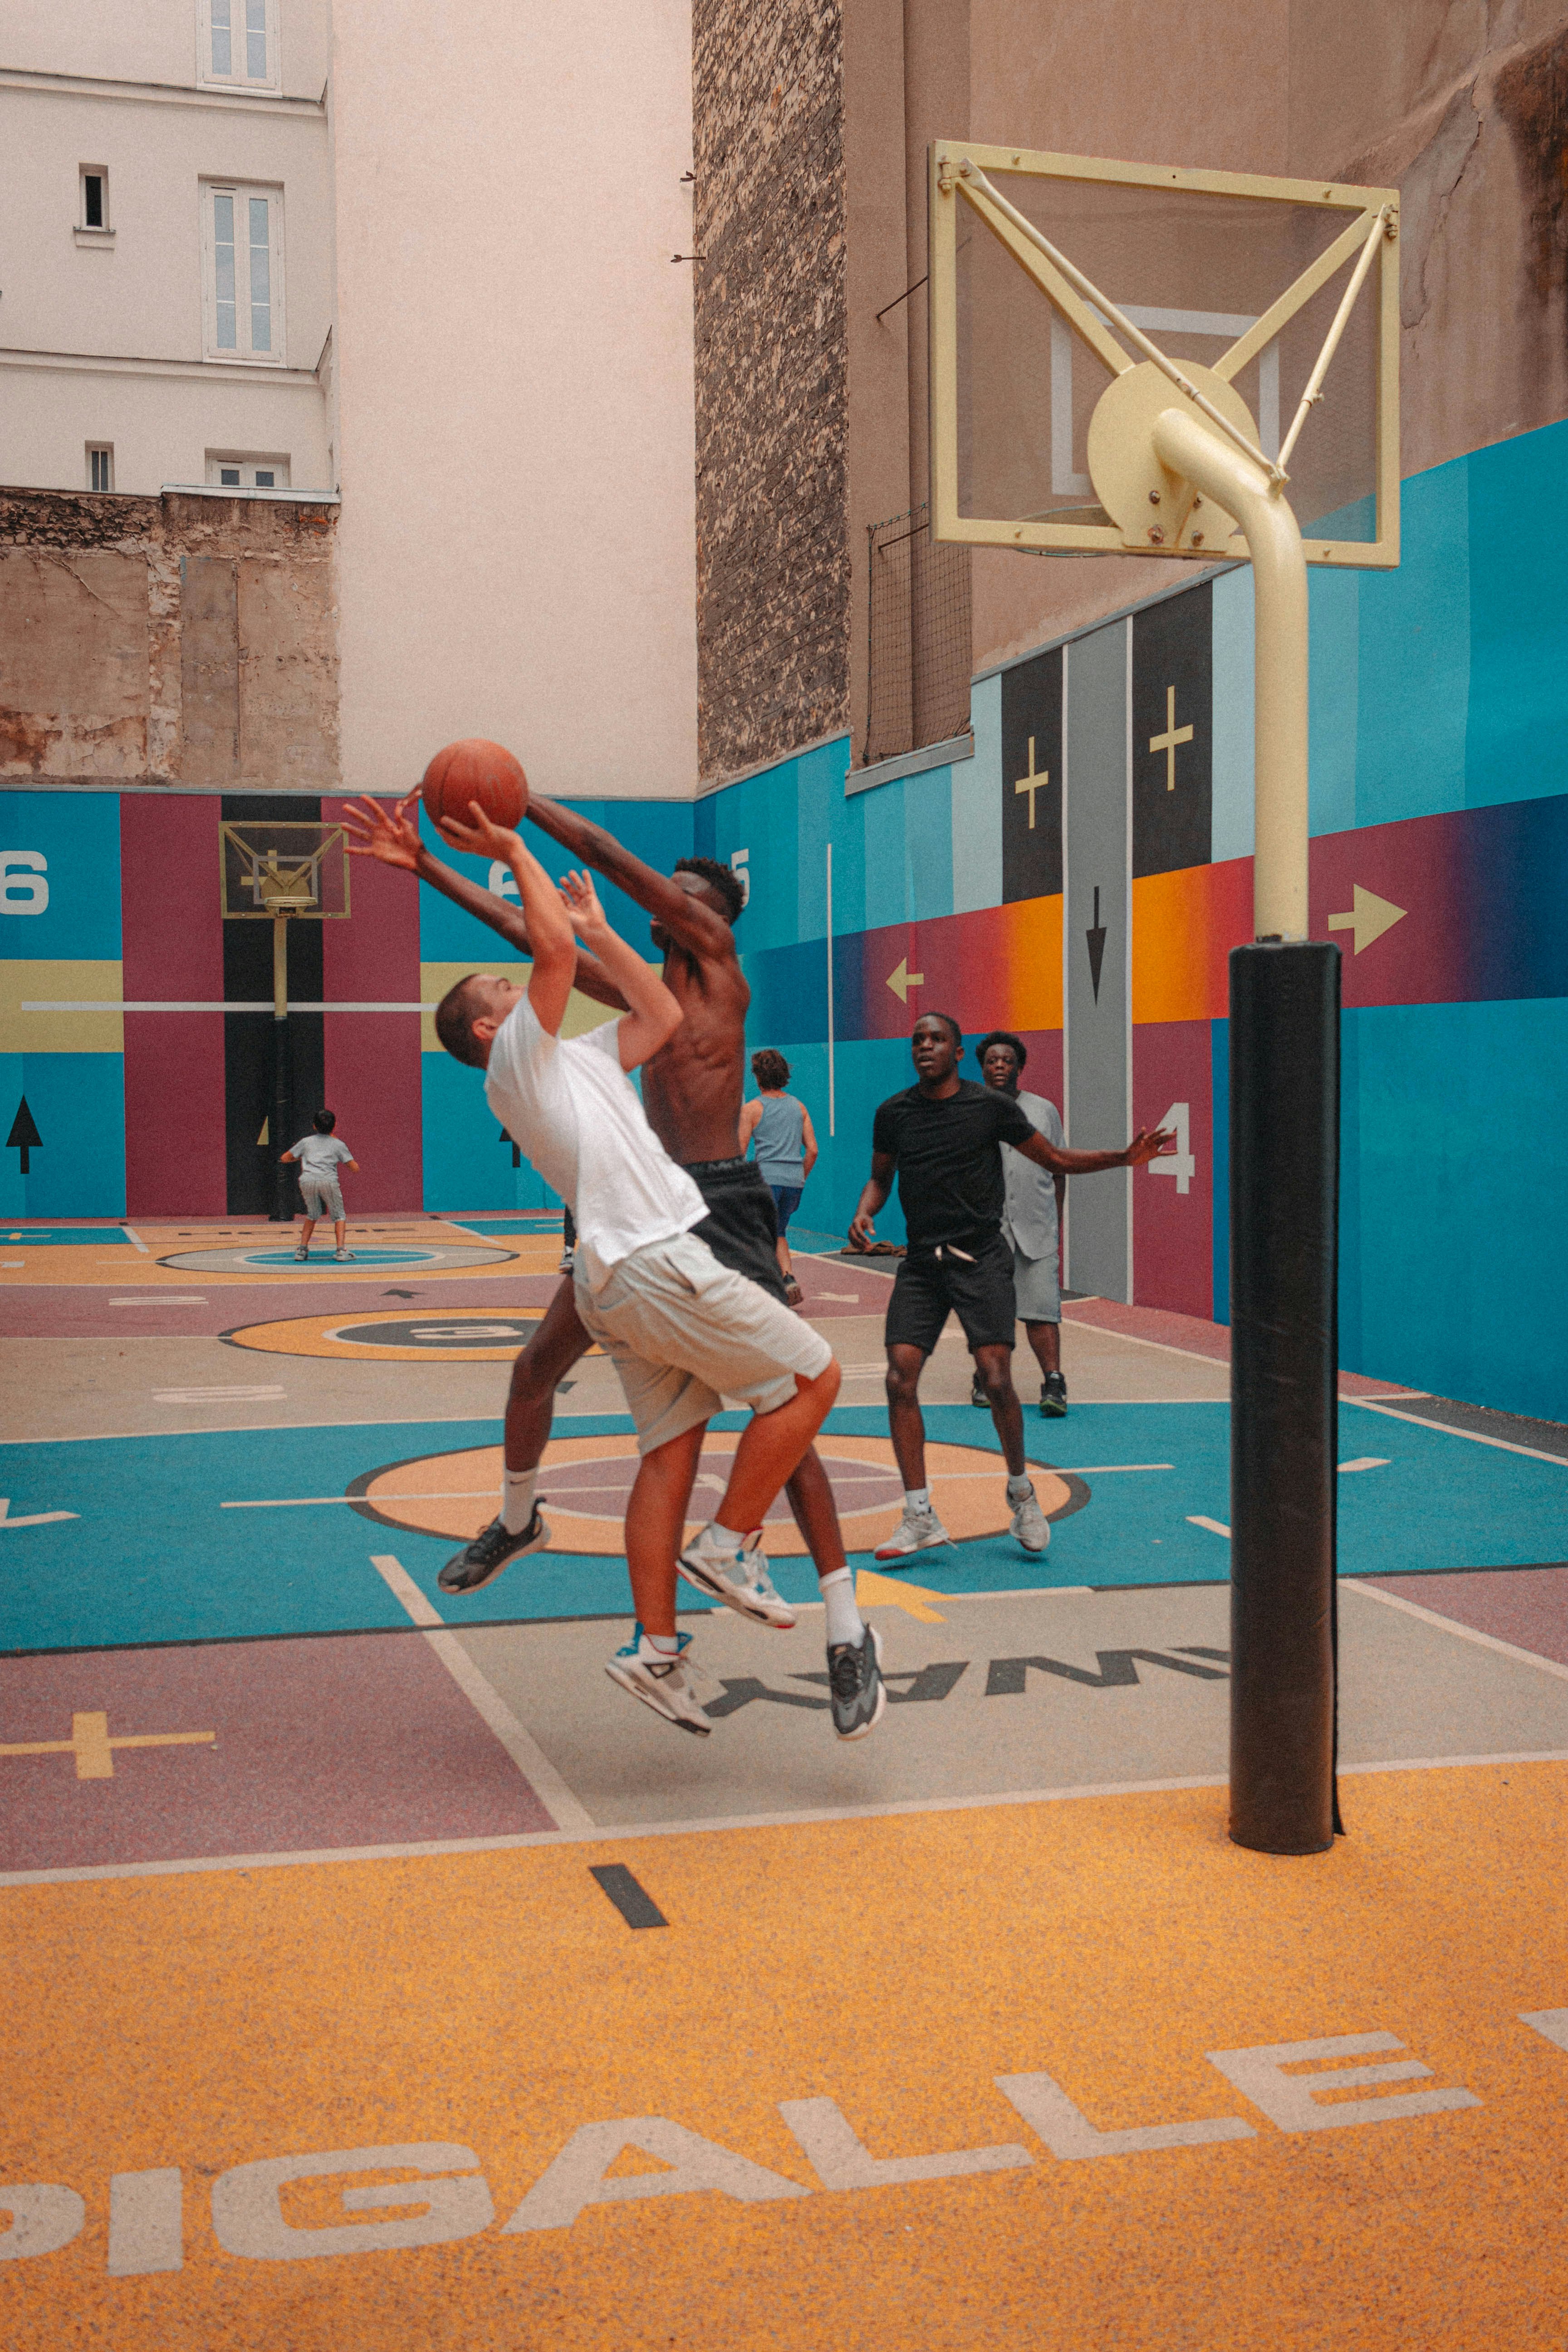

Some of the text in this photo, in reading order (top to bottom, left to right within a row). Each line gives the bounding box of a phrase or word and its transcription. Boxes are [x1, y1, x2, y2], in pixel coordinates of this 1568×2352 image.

[0, 850, 49, 915] 6
[1148, 1102, 1196, 1195] 4
[701, 1646, 1231, 1718] WAY
